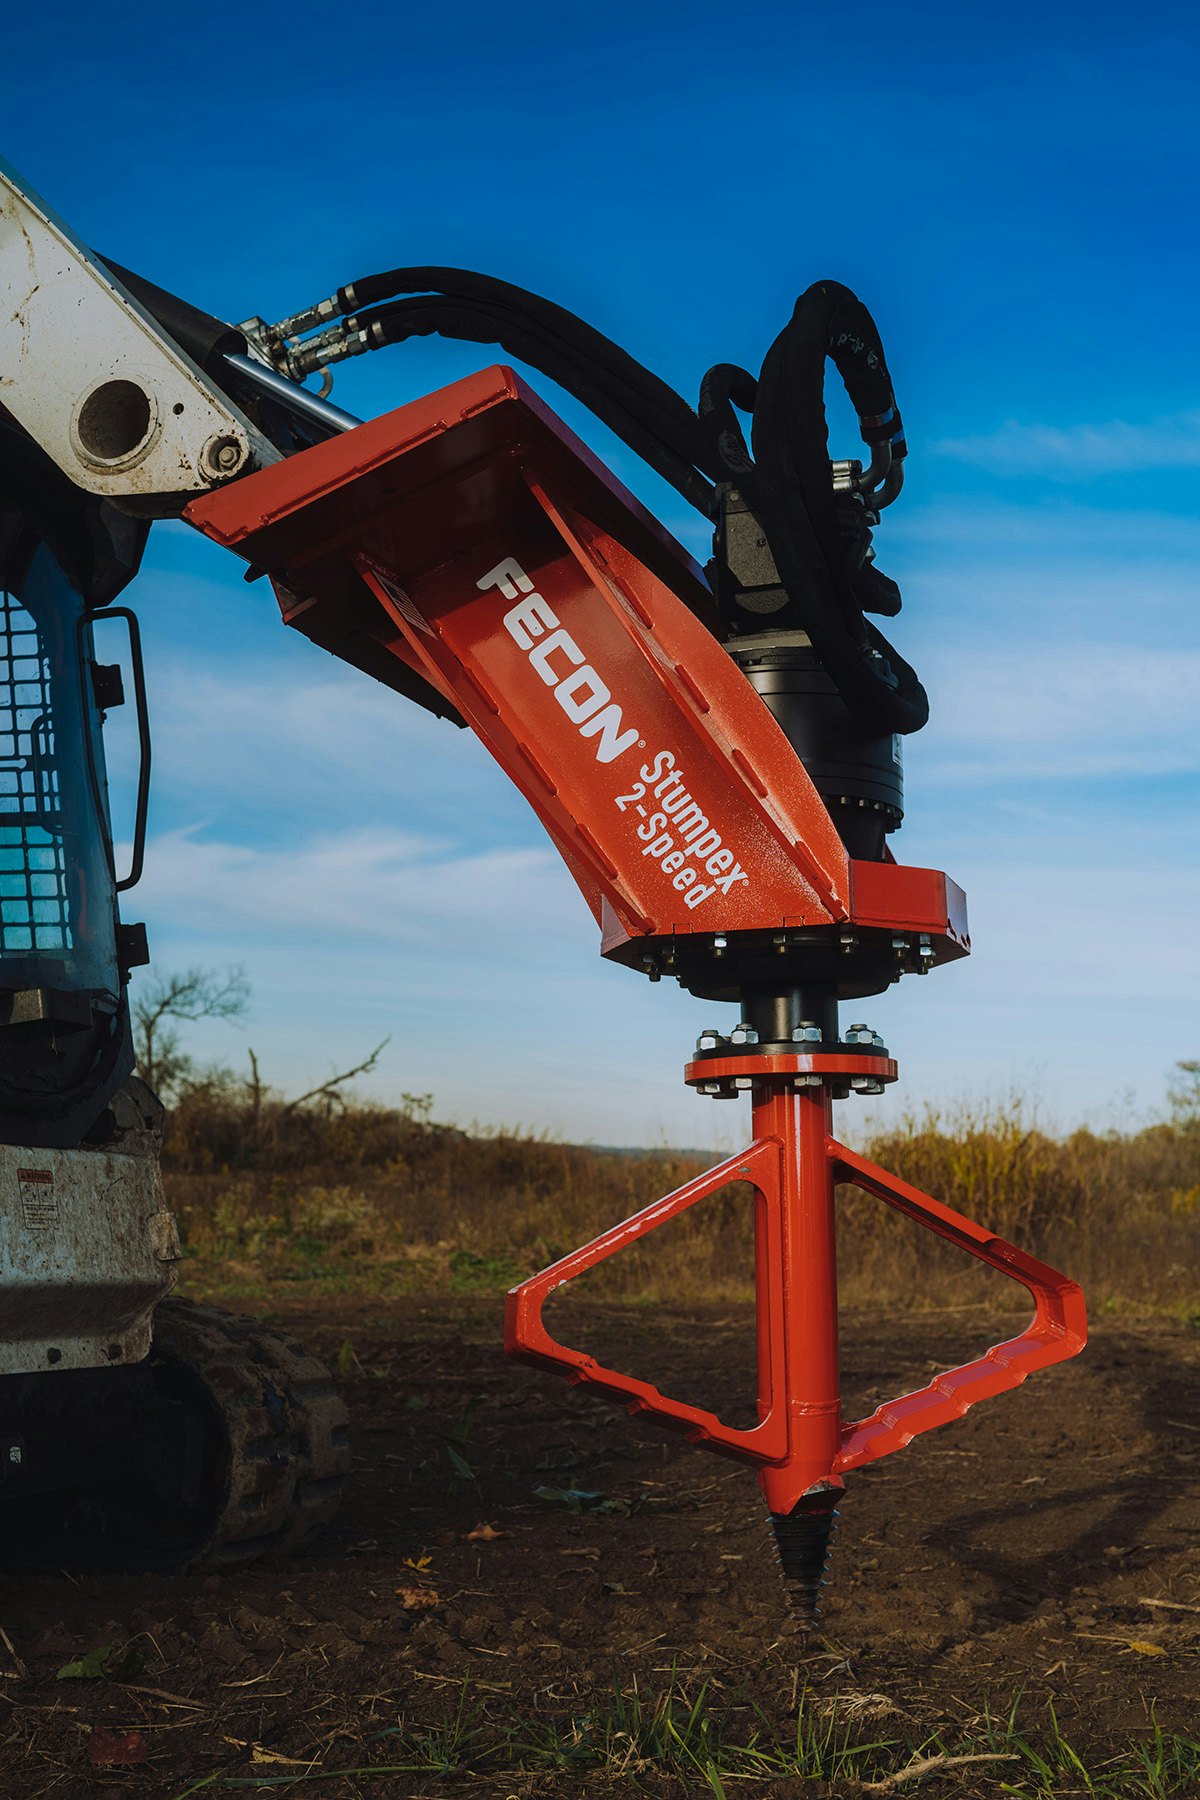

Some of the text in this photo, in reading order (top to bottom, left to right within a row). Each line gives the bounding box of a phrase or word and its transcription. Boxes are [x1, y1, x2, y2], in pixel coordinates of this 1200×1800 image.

[476, 557, 640, 764] FECON
[614, 783, 716, 910] 2-Speed
[640, 750, 749, 895] Stumpex
